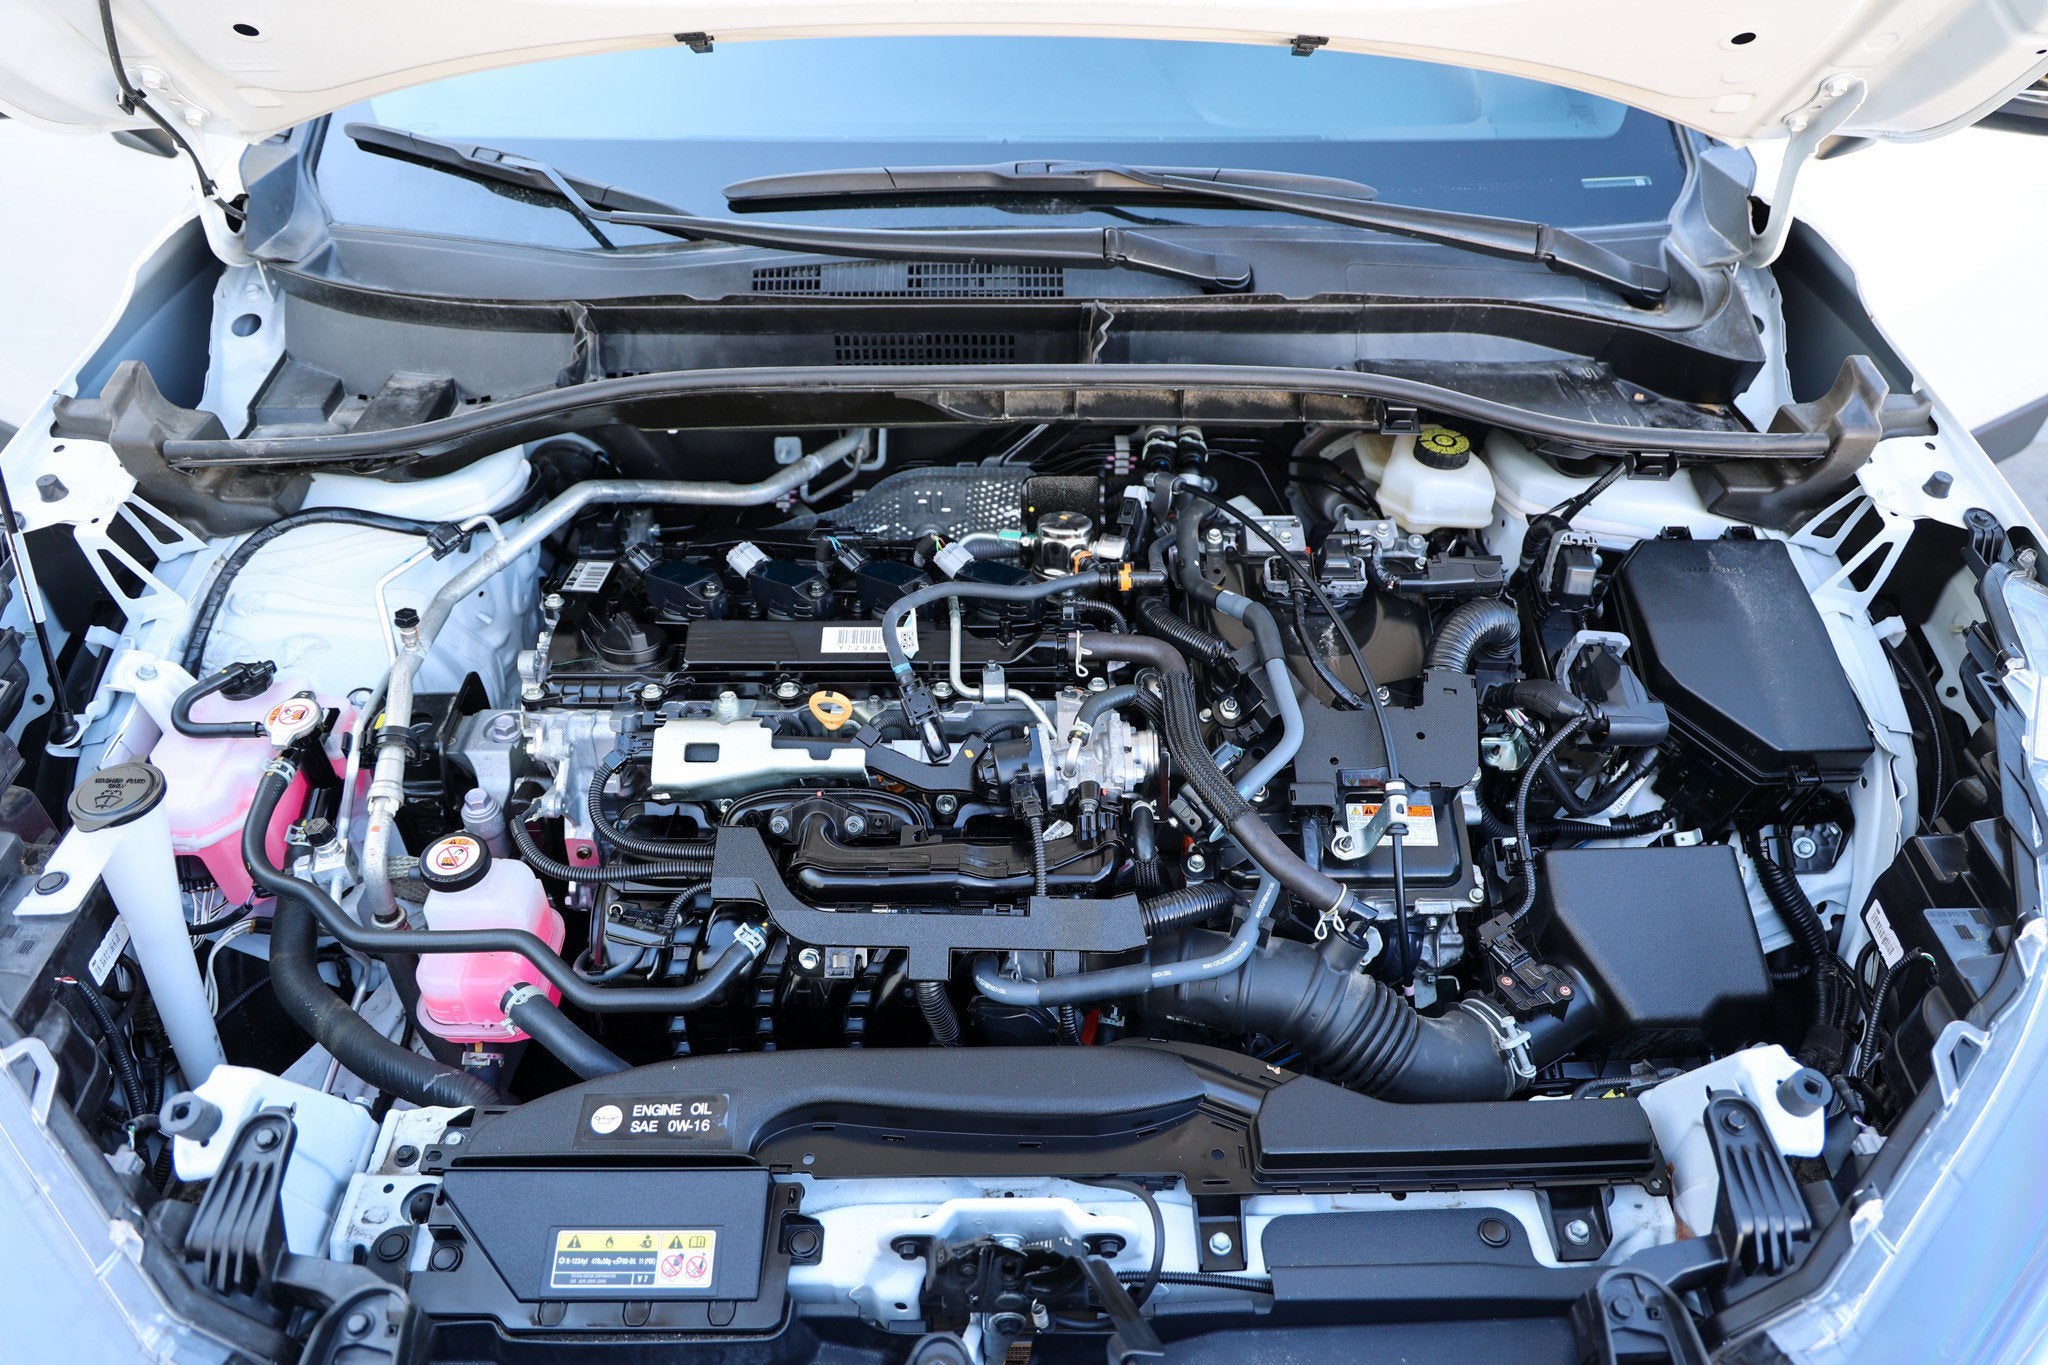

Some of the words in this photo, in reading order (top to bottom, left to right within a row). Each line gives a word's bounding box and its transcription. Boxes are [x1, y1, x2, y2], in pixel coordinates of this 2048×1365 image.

[632, 1103, 682, 1117] ENGINE
[690, 1102, 713, 1115] OIL
[630, 1120, 659, 1133] SAE
[667, 1119, 711, 1132] 0W-16
